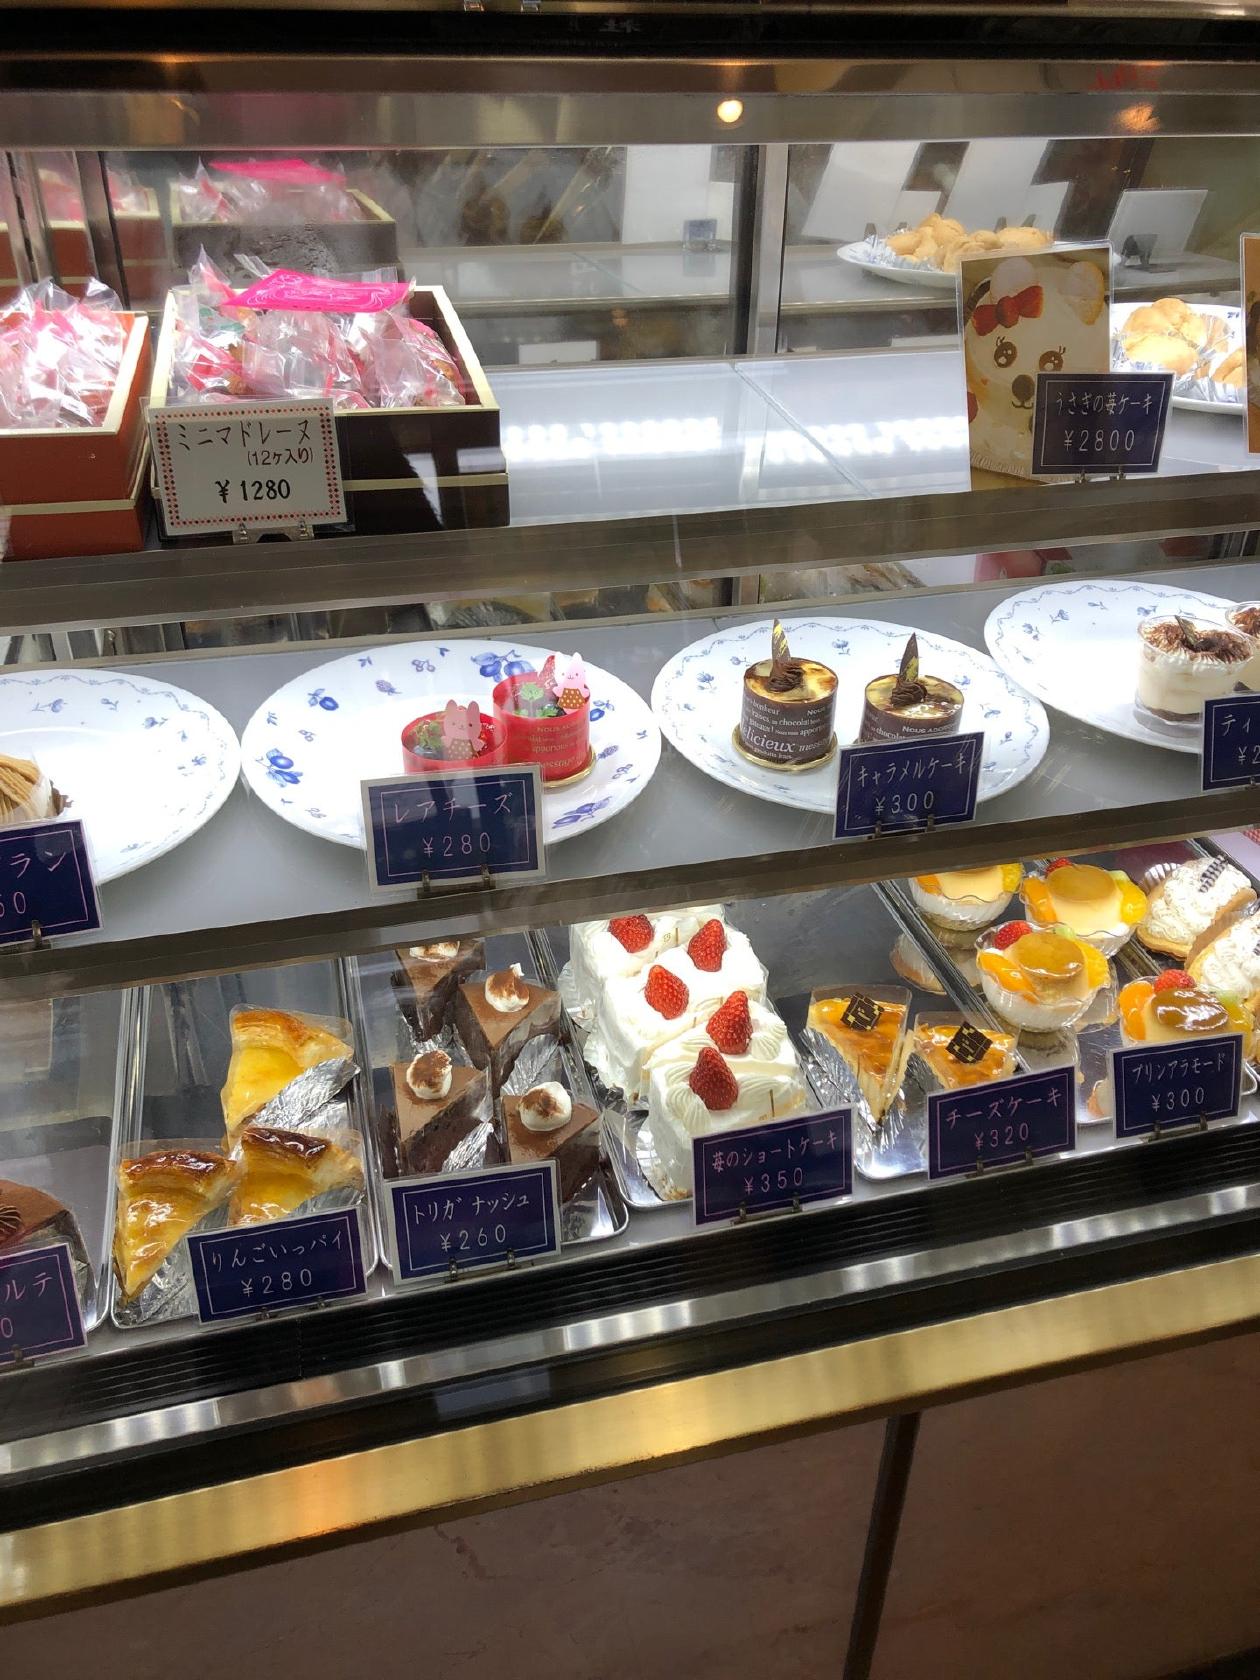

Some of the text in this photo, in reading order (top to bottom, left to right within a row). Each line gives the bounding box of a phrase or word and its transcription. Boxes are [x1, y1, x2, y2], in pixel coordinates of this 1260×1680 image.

[1056, 391, 1152, 415] うさぎの苺ケーキ
[178, 419, 311, 451] ミニマドレーヌ
[1064, 429, 1135, 452] ¥2800
[1221, 714, 1251, 737] ティ
[857, 752, 966, 788] キャラメルケーキ
[394, 792, 513, 824] レアチーズ
[875, 790, 934, 816] ¥300
[422, 832, 491, 858] ¥280
[9, 851, 67, 879] ラン
[946, 1087, 1062, 1130] チーズケーキ
[1152, 1087, 1205, 1112] ¥300
[712, 1129, 838, 1173] 苺のショートケーキ
[974, 1122, 1029, 1151] ¥320
[743, 1167, 803, 1195] ¥350
[212, 1230, 342, 1272] りんごいっパイ
[440, 1223, 506, 1252] ¥260
[4, 1272, 54, 1303] ルテ
[241, 1268, 312, 1297] ¥280
